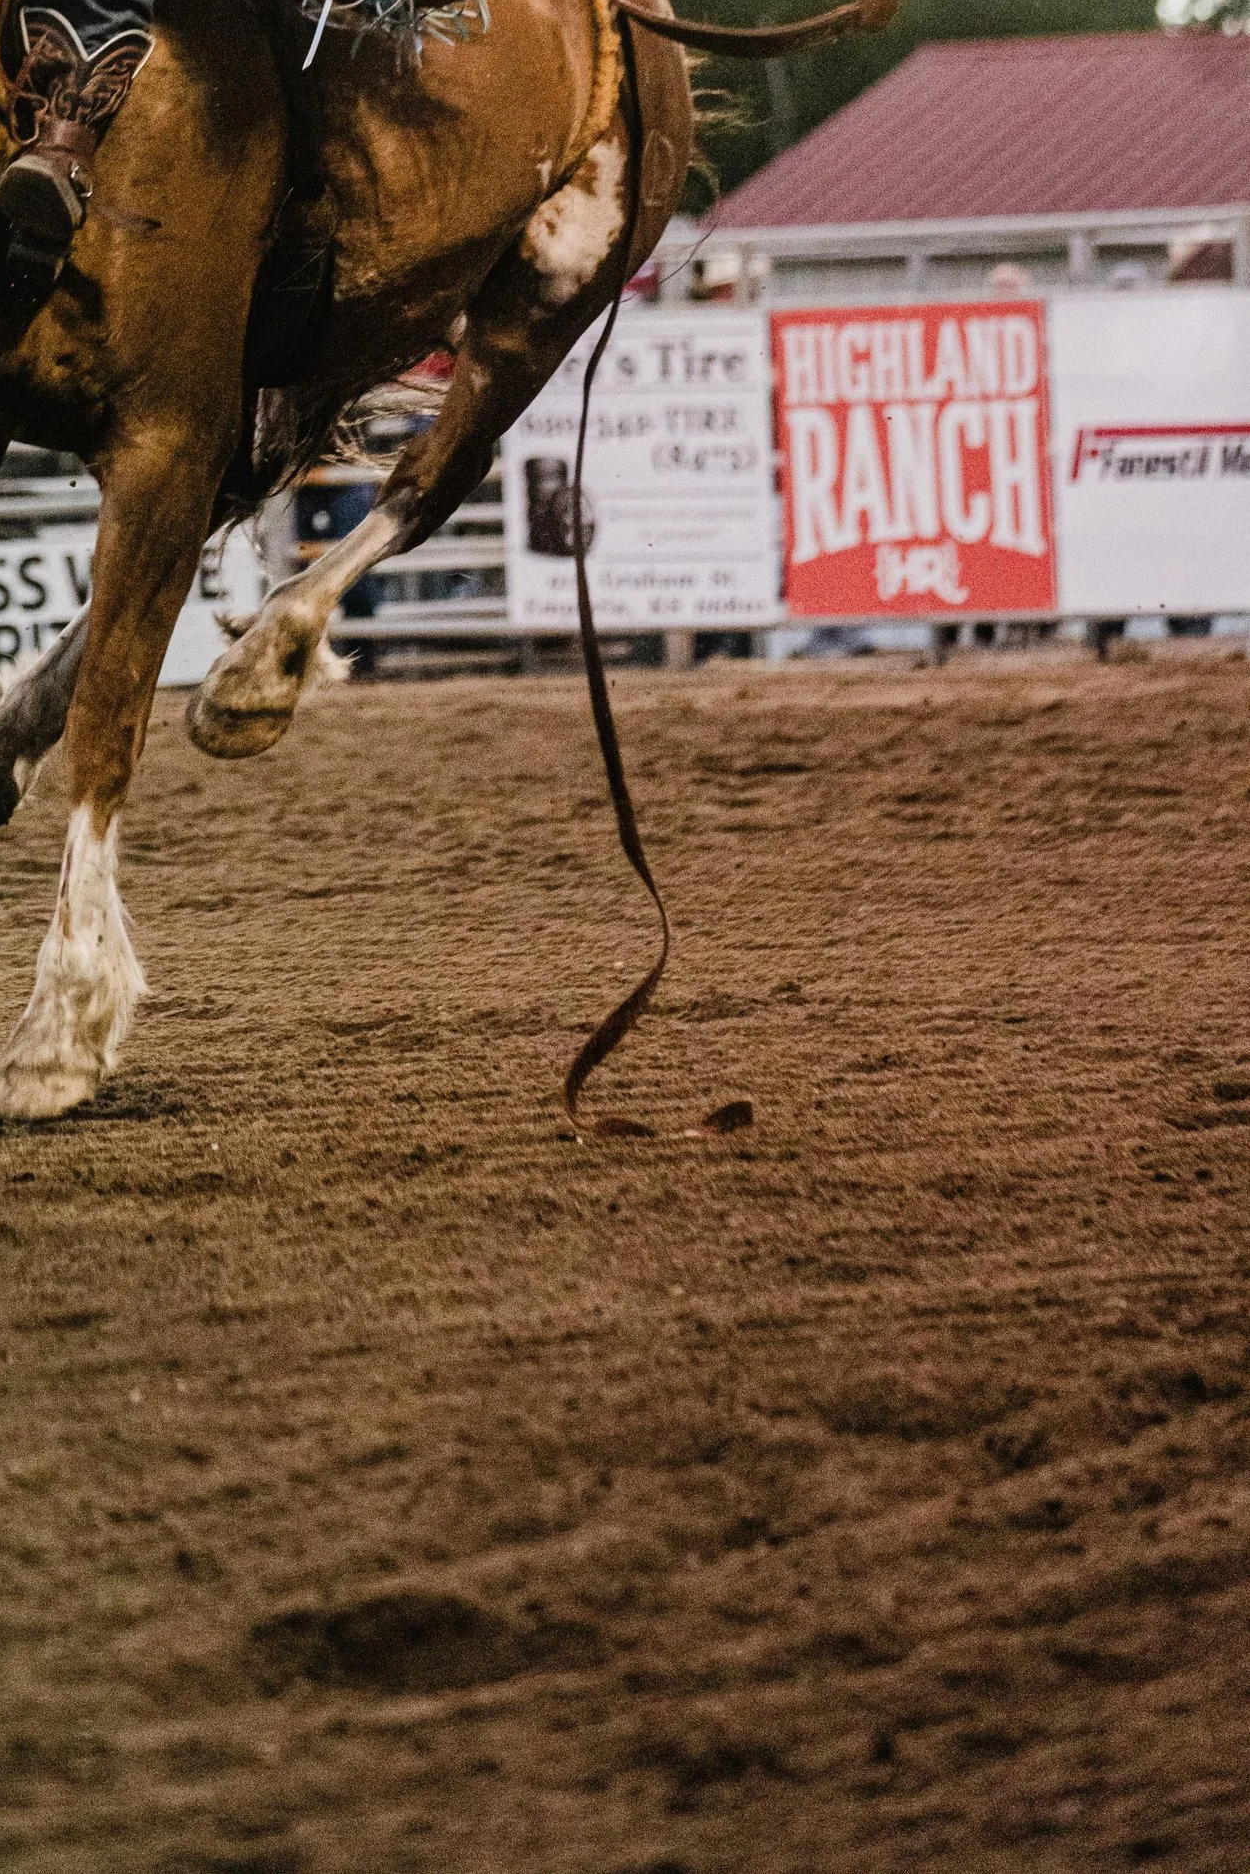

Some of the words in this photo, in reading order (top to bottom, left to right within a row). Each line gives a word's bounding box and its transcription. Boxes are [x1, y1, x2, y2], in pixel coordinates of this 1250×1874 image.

[651, 334, 743, 383] Tire
[783, 316, 1039, 403] HIGHLAND
[786, 398, 1047, 566] RANCH
